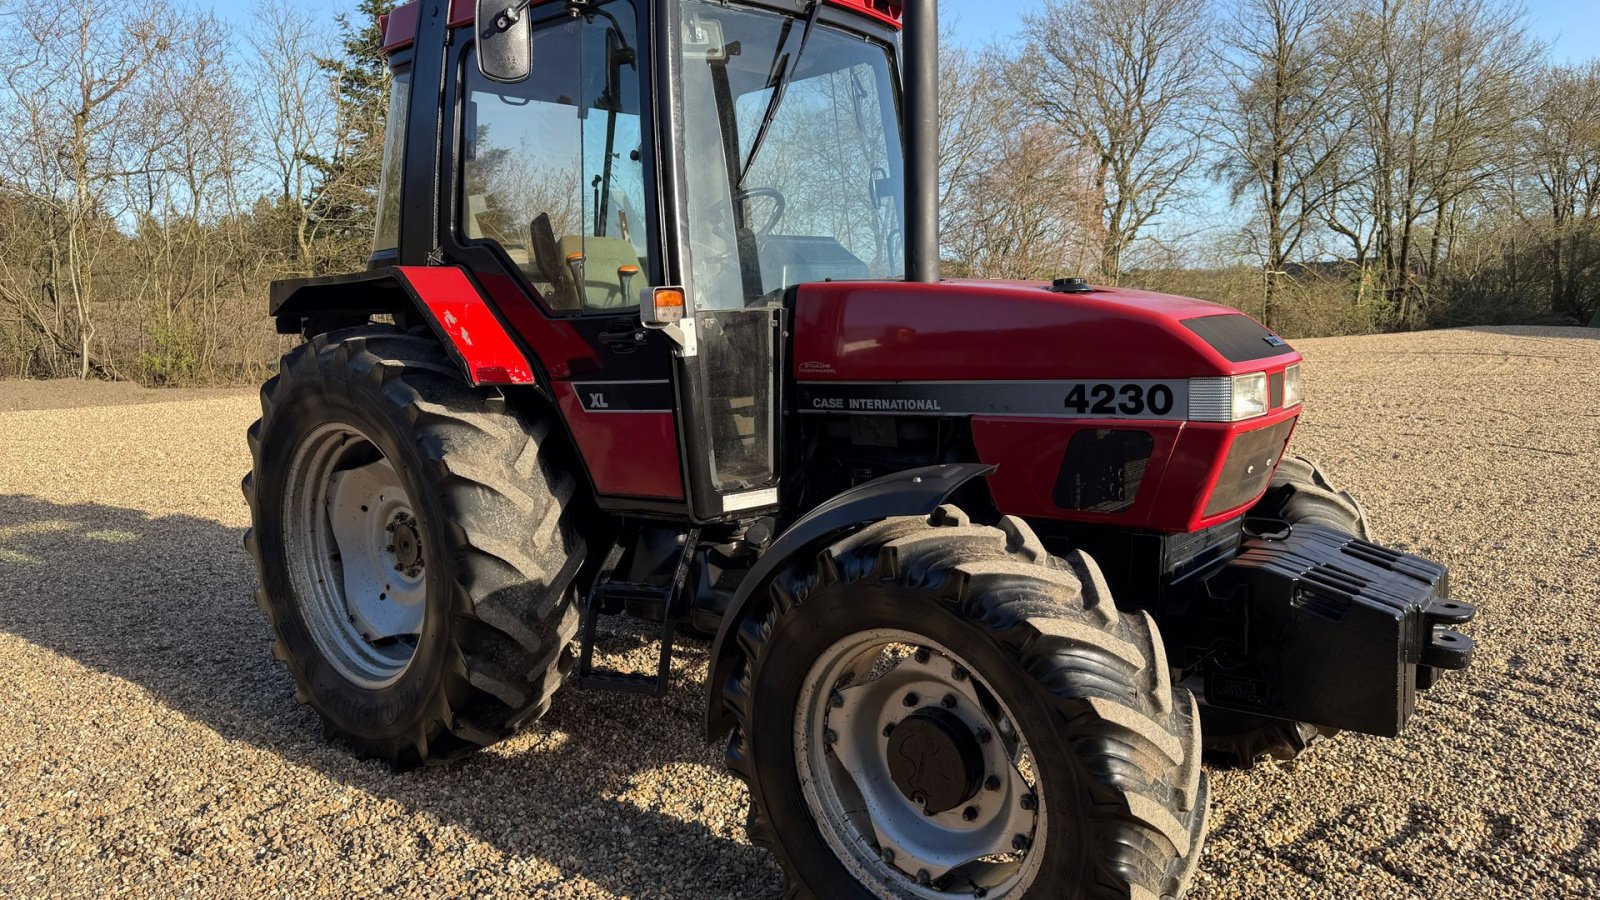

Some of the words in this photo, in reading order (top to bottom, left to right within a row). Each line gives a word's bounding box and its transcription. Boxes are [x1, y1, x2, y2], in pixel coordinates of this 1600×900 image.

[589, 393, 608, 408] XL
[812, 397, 844, 409] CASE
[849, 398, 941, 410] INTERNATIONAL
[1064, 384, 1173, 415] 4230
